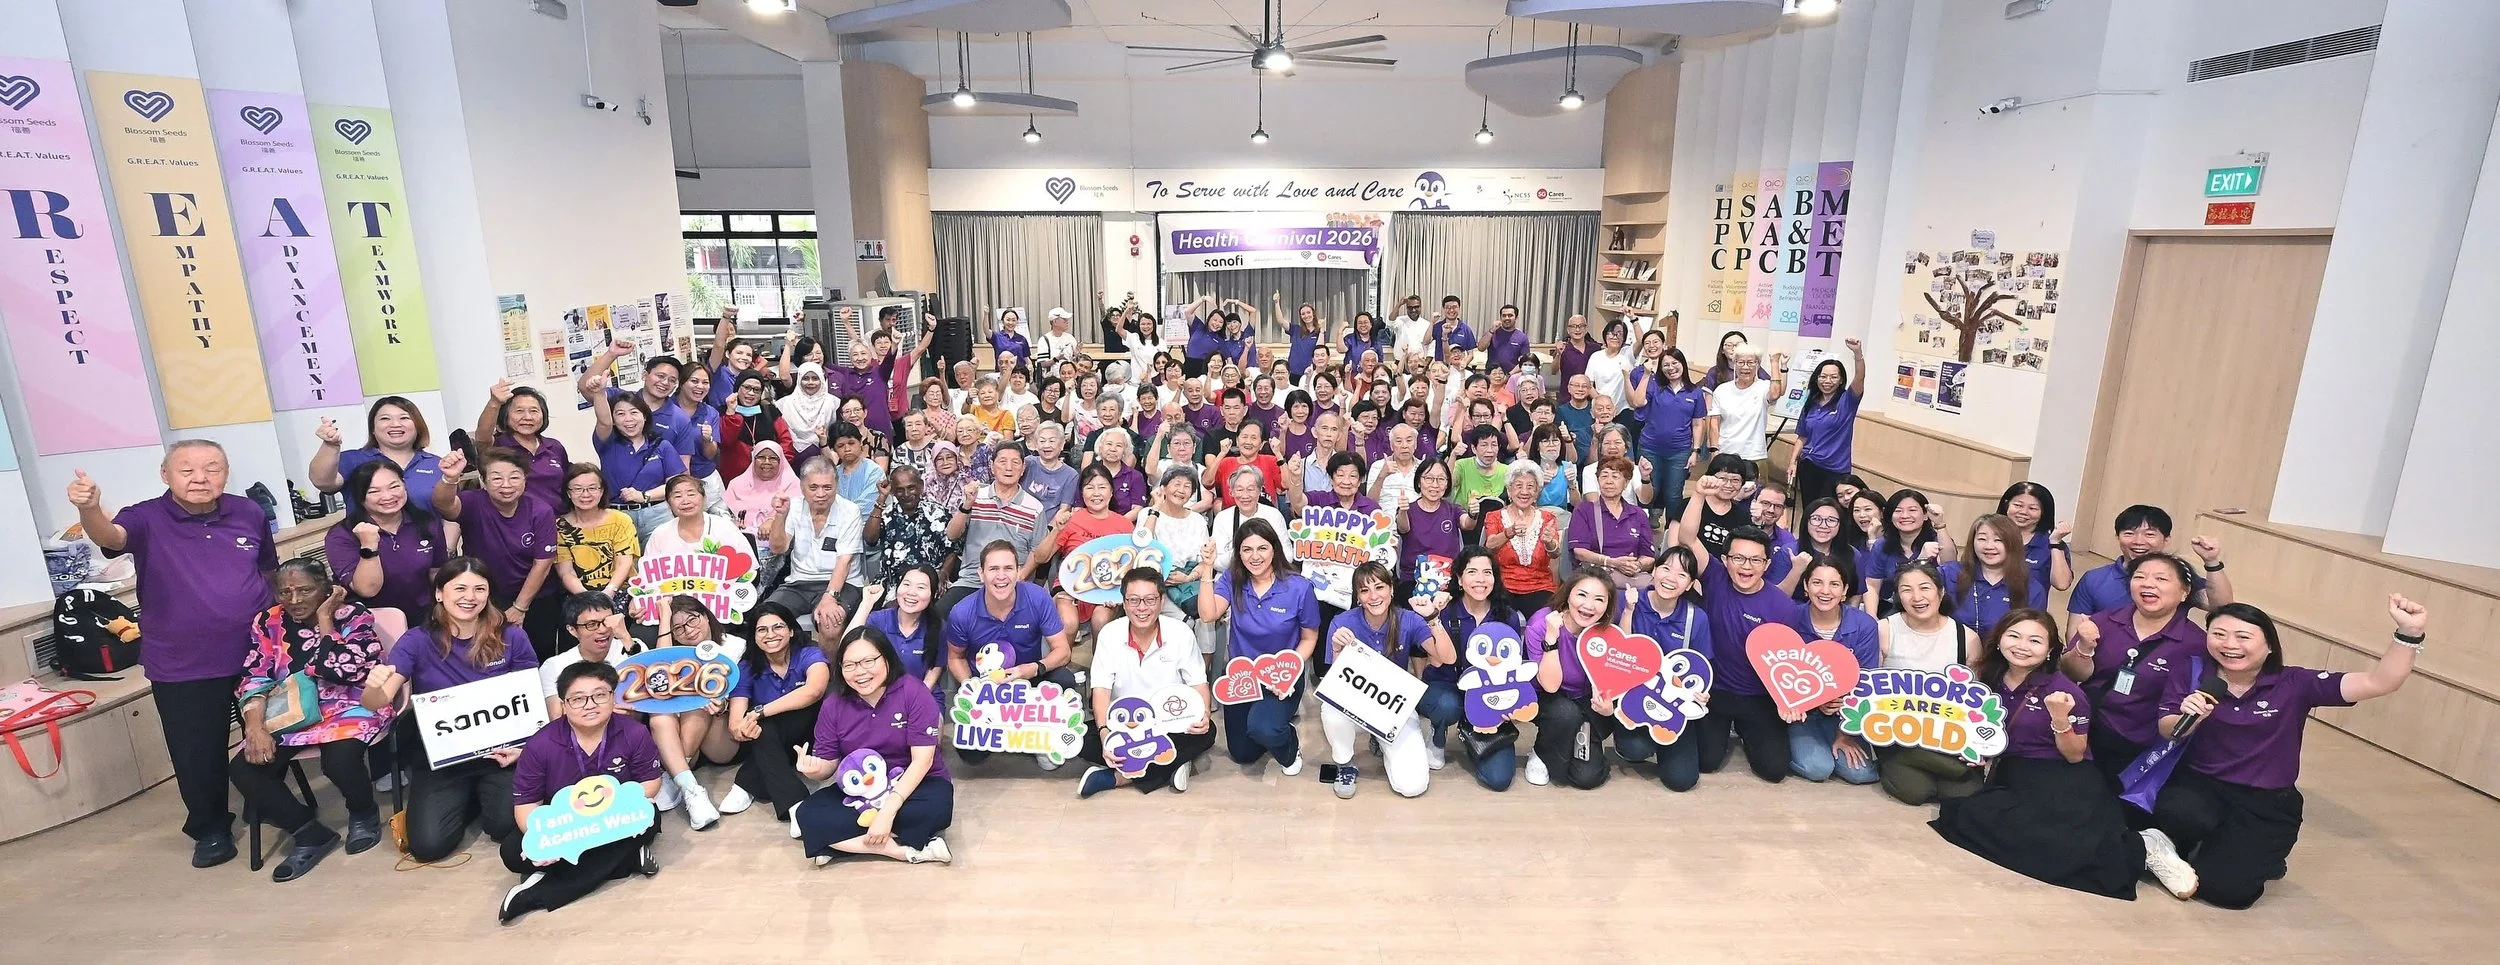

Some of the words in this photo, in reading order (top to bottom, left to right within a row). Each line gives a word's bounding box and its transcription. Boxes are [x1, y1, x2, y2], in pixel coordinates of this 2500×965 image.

[26, 119, 57, 128] Seeds
[124, 127, 160, 136] Blossom
[162, 128, 187, 137] Seeds
[240, 139, 271, 147] Blossom
[272, 140, 294, 148] Seeds
[35, 152, 71, 162] Values
[169, 159, 199, 167] Values
[242, 166, 277, 174] G.R.E.A.T.
[278, 167, 303, 175] Values
[1147, 181, 1169, 198] To
[1176, 181, 1226, 198] Serve
[1233, 181, 1269, 197] with
[1276, 181, 1318, 198] Love
[1325, 181, 1359, 197] and
[1361, 180, 1404, 201] Care
[2211, 172, 2246, 192] EXIT
[1179, 232, 1239, 249] Health
[1326, 230, 1373, 246] 2026
[1204, 254, 1244, 268] sanofi
[1305, 508, 1375, 536] HAPPY
[1335, 532, 1347, 542] IS
[1296, 540, 1371, 566] HEALTH
[643, 554, 726, 584] HEALTH
[682, 580, 695, 590] IS
[1743, 613, 1762, 623] sanofi
[1671, 632, 1685, 640] sano
[1590, 641, 1604, 653] SG
[1608, 647, 1637, 663] Cares
[485, 658, 506, 667] anofi
[1259, 664, 1275, 676] Age
[1761, 648, 1838, 689] Healthier
[617, 658, 732, 703] 2026
[1227, 670, 1252, 698] Healthier
[1270, 670, 1292, 684] SG
[1779, 672, 1812, 695] SG
[976, 684, 1027, 705] AGE
[1239, 681, 1253, 695] SG
[1339, 667, 1407, 714] sanofi
[1853, 673, 1987, 708] SENIORS
[435, 693, 530, 736] sanofi
[1000, 704, 1067, 724] WELL.
[1903, 700, 1942, 715] ARE
[956, 725, 1003, 748] LIVE
[1863, 713, 1967, 751] GOLD
[534, 818, 541, 832] I
[546, 812, 574, 829] am
